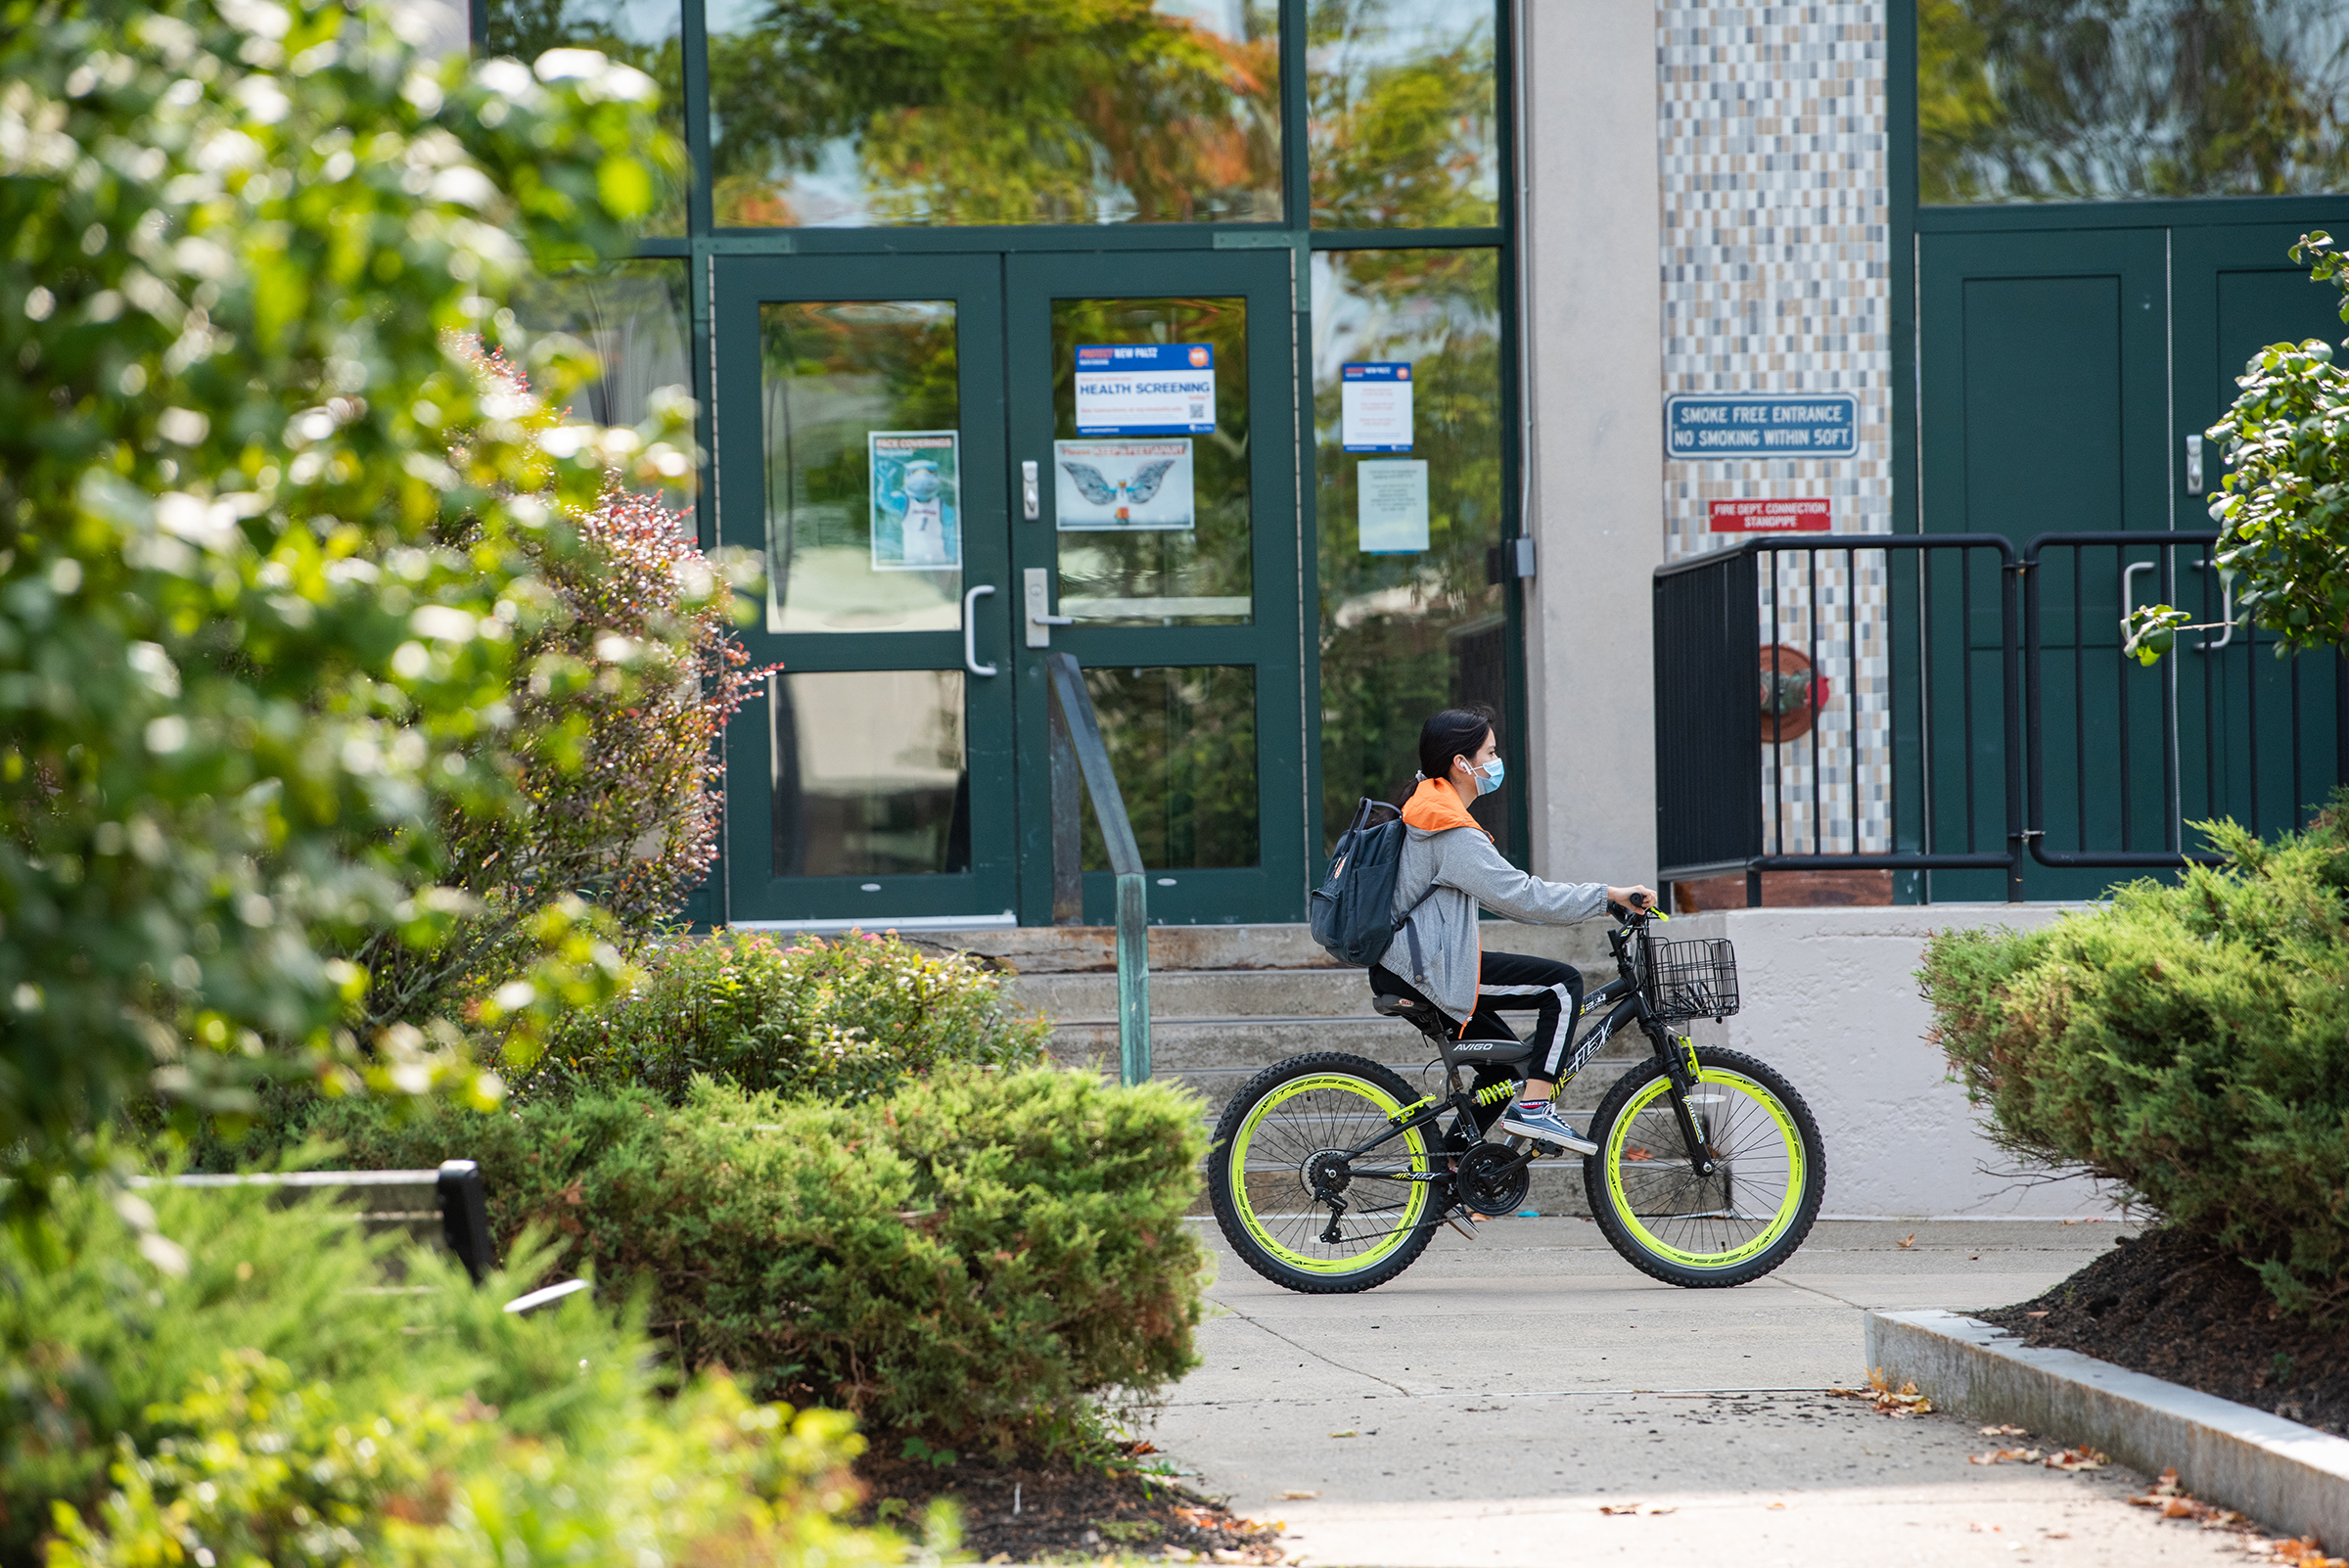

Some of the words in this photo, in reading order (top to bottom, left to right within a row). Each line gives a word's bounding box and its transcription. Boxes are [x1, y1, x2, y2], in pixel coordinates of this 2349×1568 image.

[1114, 347, 1133, 358] NEW
[1135, 347, 1158, 358] PALTZ
[1081, 383, 1131, 394] HEALTH
[1135, 381, 1211, 393] SCREENING
[1681, 406, 1728, 423] SMOKE
[1732, 406, 1769, 423] FREE
[1773, 405, 1843, 423] ENTRANCE
[876, 438, 899, 448] FACE
[900, 438, 952, 448] COVERINGS
[1675, 430, 1694, 446] NO
[1698, 430, 1761, 446] SMOKING
[1764, 429, 1809, 445] WITHIN
[1715, 503, 1735, 515] FIRE
[1766, 502, 1826, 514] CONNECTION
[1744, 515, 1798, 528] STANDPIPE
[1452, 1042, 1494, 1052] AVIGO
